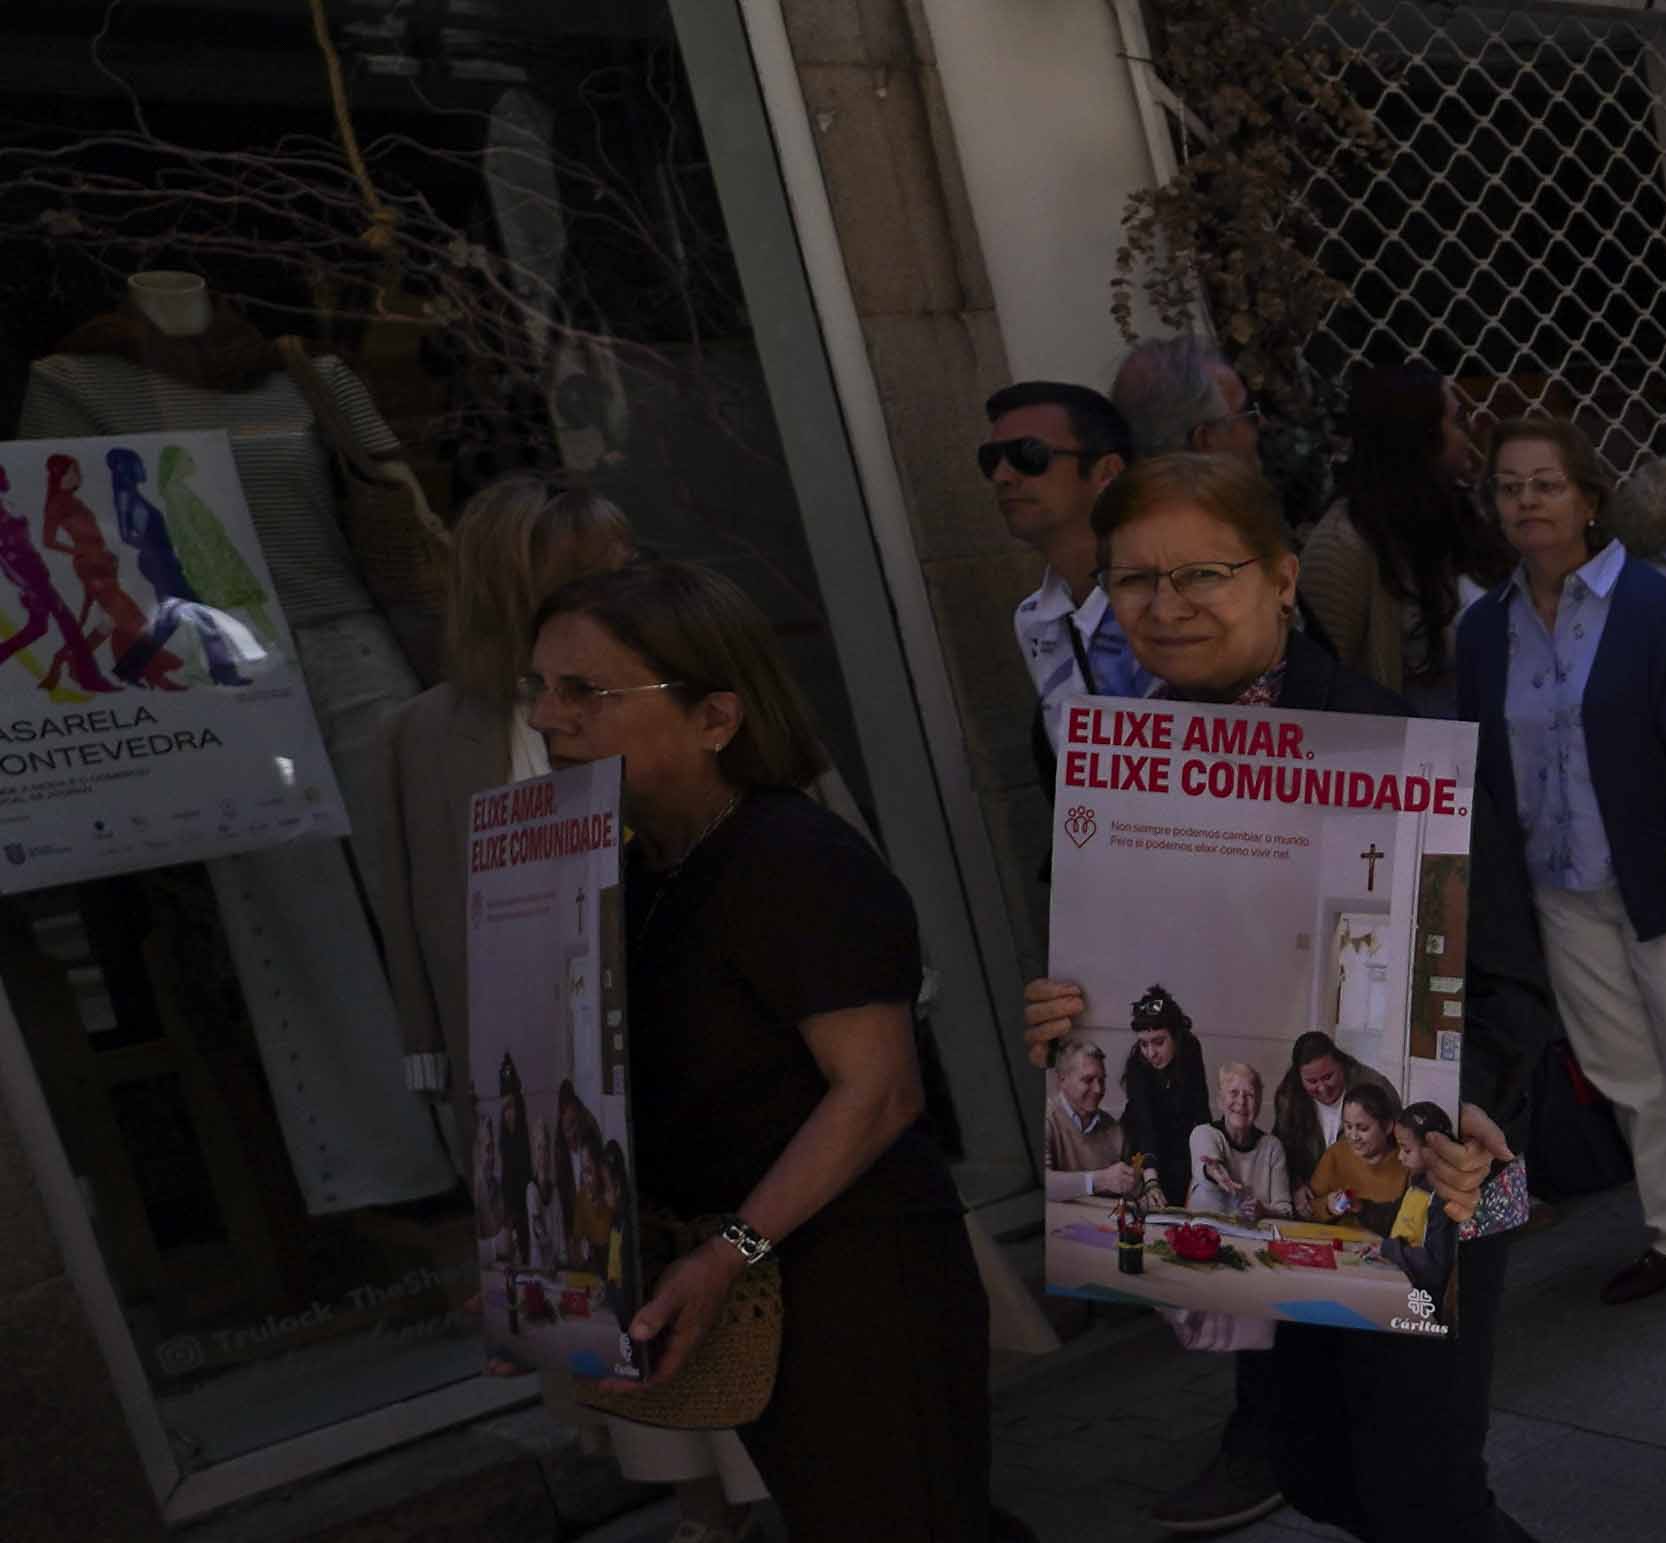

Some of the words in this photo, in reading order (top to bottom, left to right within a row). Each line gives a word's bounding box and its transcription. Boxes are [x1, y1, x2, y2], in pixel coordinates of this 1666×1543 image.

[0, 728, 223, 776] ONTEVEDRA
[1068, 708, 1174, 751] ELIXE
[1182, 717, 1315, 760] AMAR.
[1064, 751, 1171, 793] ELIXE
[1181, 759, 1468, 817] COMUNIDADE.
[473, 792, 509, 833] ELIXE
[472, 833, 507, 873] ELIXE
[1145, 840, 1193, 853] podemos
[1220, 846, 1250, 857] como
[1173, 827, 1220, 840] podemos
[1390, 1316, 1449, 1335] Cáritas
